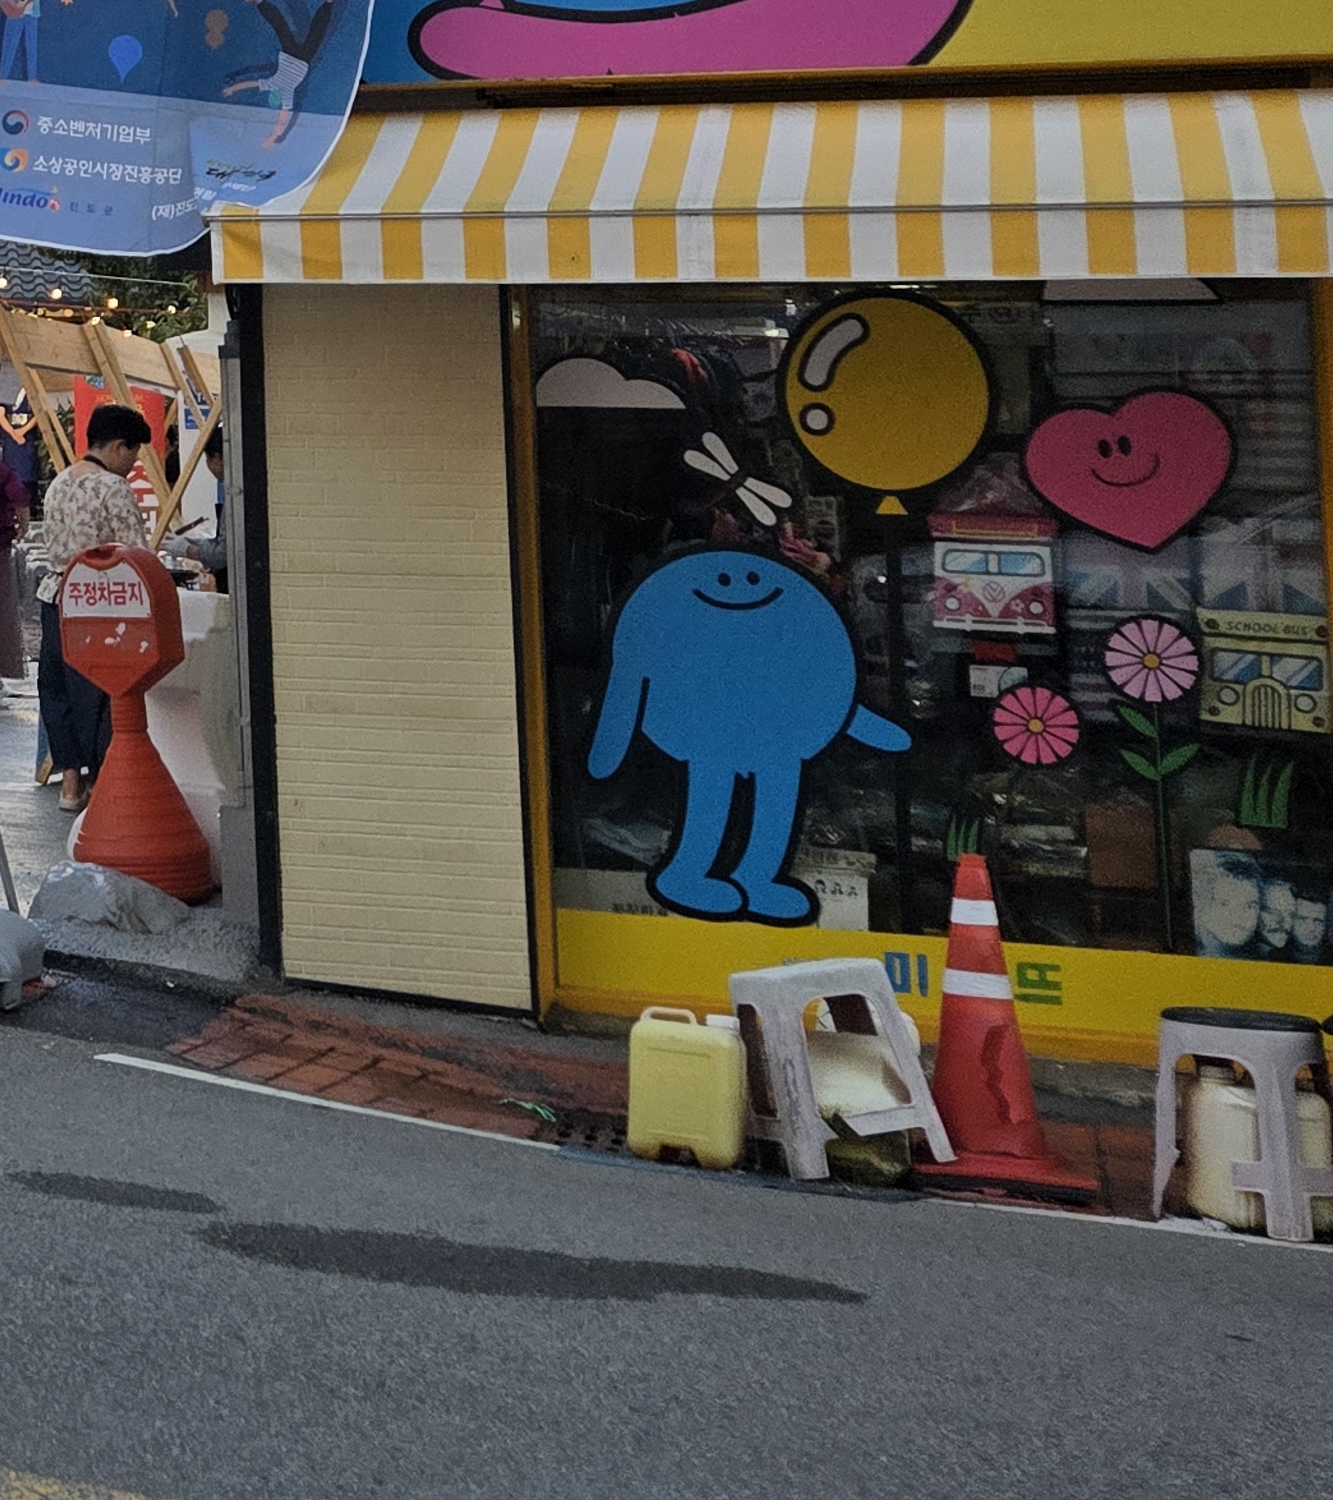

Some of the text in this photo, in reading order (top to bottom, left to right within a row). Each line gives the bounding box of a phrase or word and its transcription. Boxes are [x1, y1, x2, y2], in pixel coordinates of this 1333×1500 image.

[37, 116, 151, 145] 중소벤처기업부
[33, 155, 182, 185] 소상공인시장진흥공단
[69, 581, 144, 606] 주정차금지
[1226, 620, 1280, 635] SCHOOL
